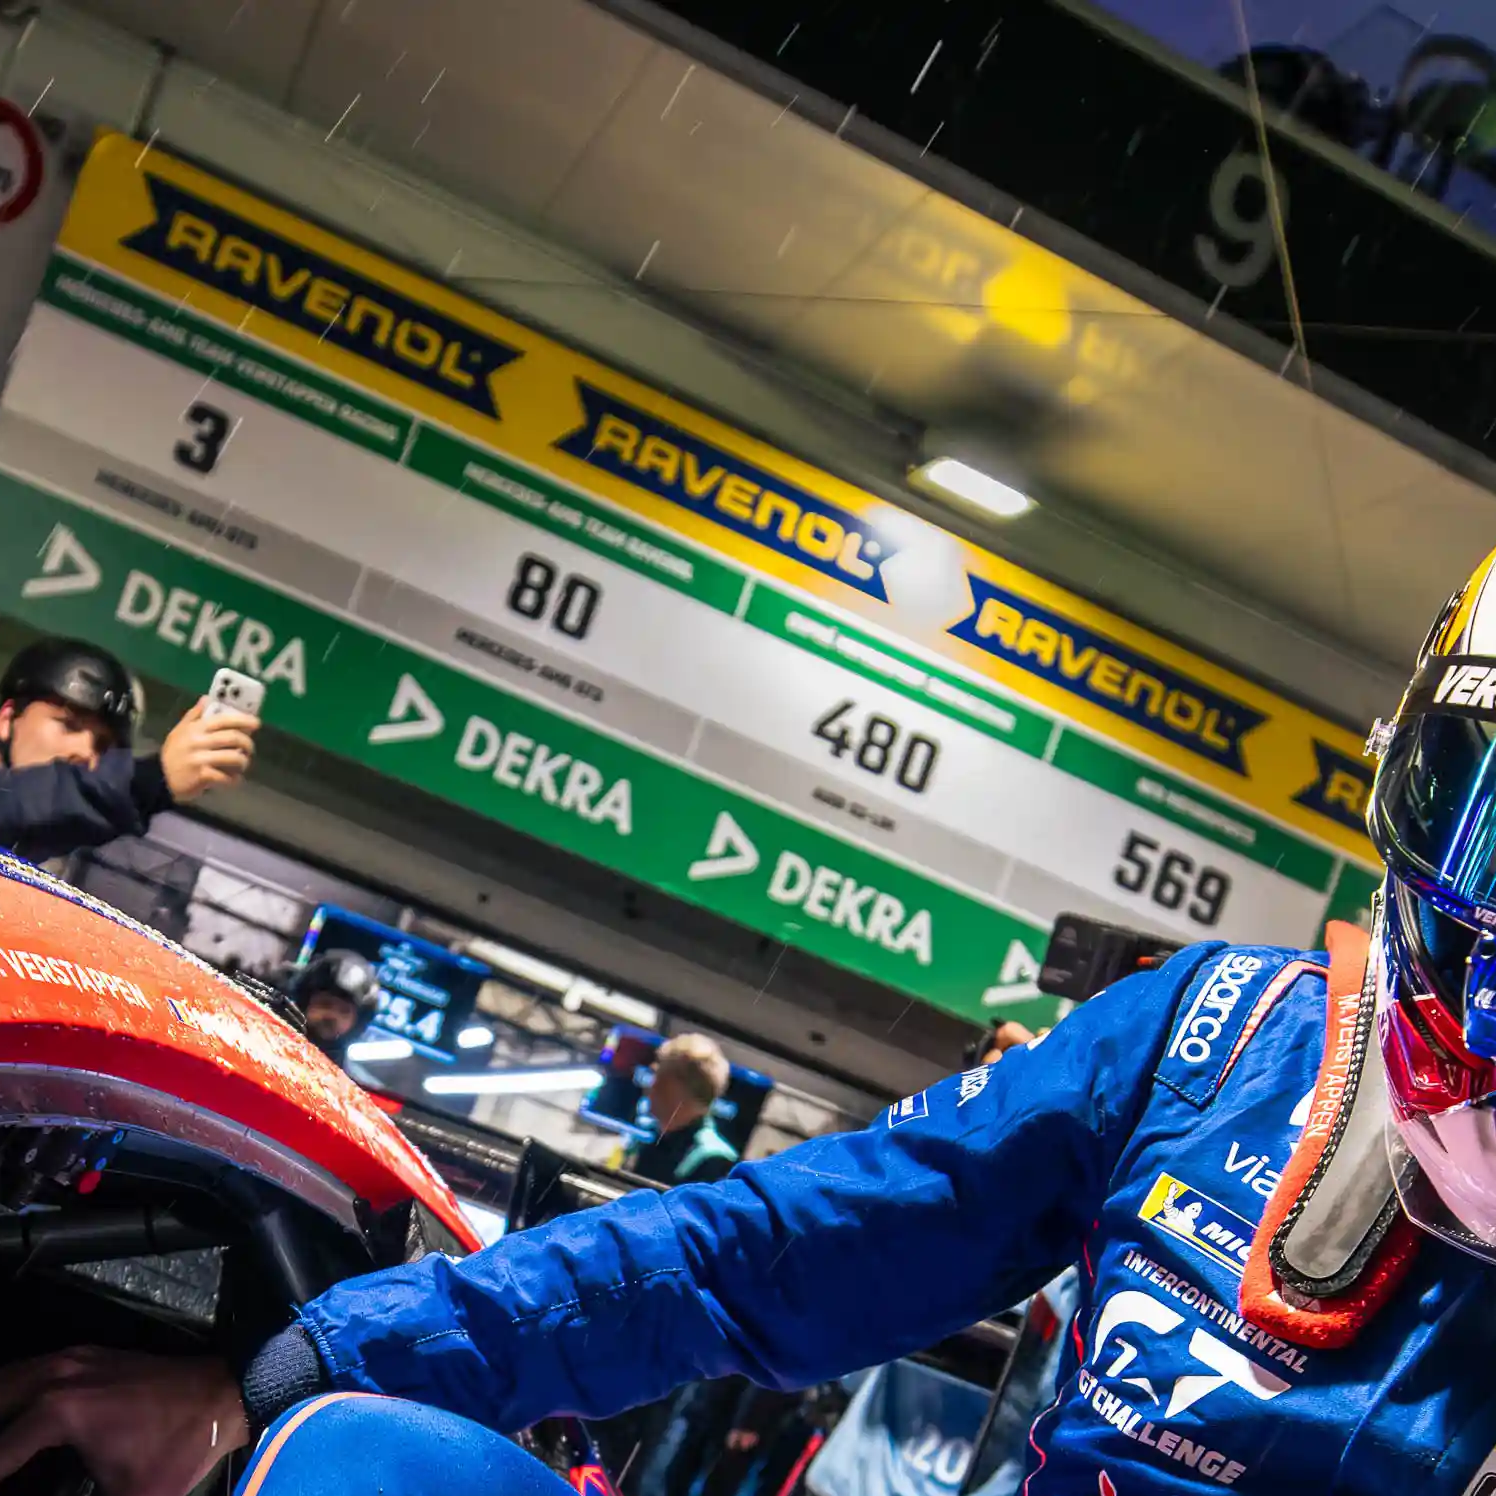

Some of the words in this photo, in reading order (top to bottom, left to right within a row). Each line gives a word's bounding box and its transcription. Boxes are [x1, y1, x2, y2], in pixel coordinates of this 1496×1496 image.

[1193, 150, 1289, 289] 9
[165, 209, 480, 387] RAVENOL
[173, 402, 232, 475] 3
[593, 413, 881, 582] RAVENOL
[115, 570, 308, 697] DEKRA
[505, 551, 602, 642] 80
[973, 594, 1238, 752] RAVENOL
[455, 714, 633, 836] DEKRA
[812, 698, 942, 795] 480
[767, 851, 934, 966] DEKRA
[1113, 828, 1233, 927] 569
[6, 948, 153, 1011] VERSTAPPEN
[1169, 951, 1263, 1064] sparco
[1123, 1250, 1311, 1374] INTERCONTINENTAL
[1092, 1386, 1247, 1486] CHALLENGE
